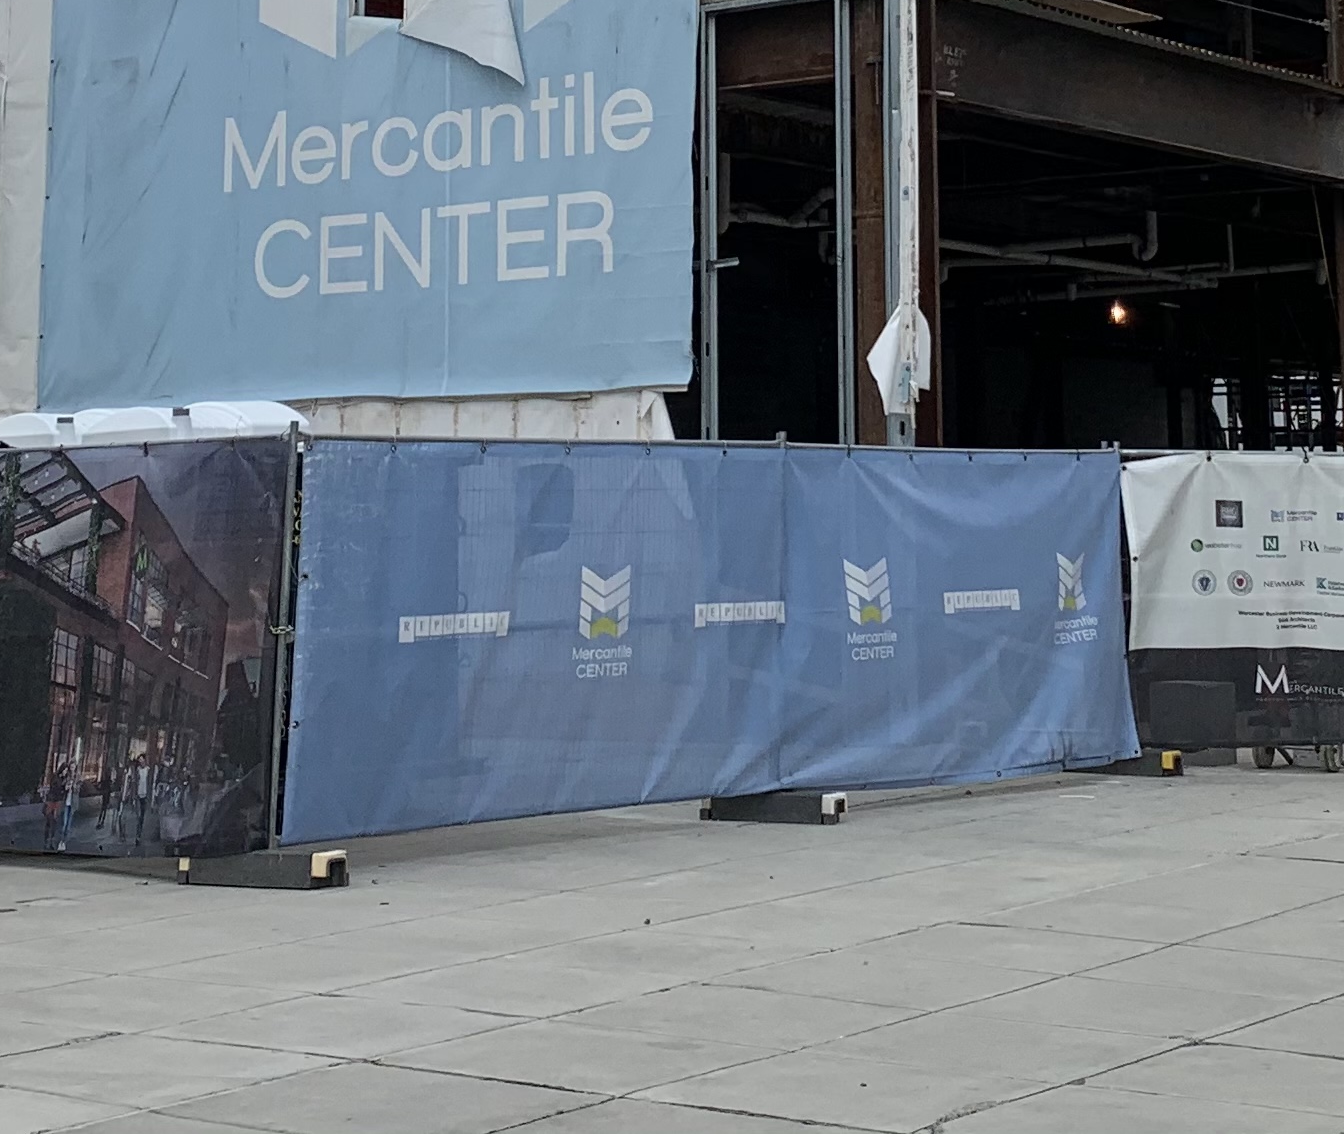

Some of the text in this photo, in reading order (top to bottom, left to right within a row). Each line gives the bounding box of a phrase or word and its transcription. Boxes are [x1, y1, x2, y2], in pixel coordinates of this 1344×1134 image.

[223, 70, 654, 193] Mercantile
[254, 190, 615, 299] CENTER
[847, 630, 898, 646] Mercantile
[571, 645, 633, 661] Mercantile
[851, 645, 895, 661] CENTER
[575, 662, 628, 679] CENTER
